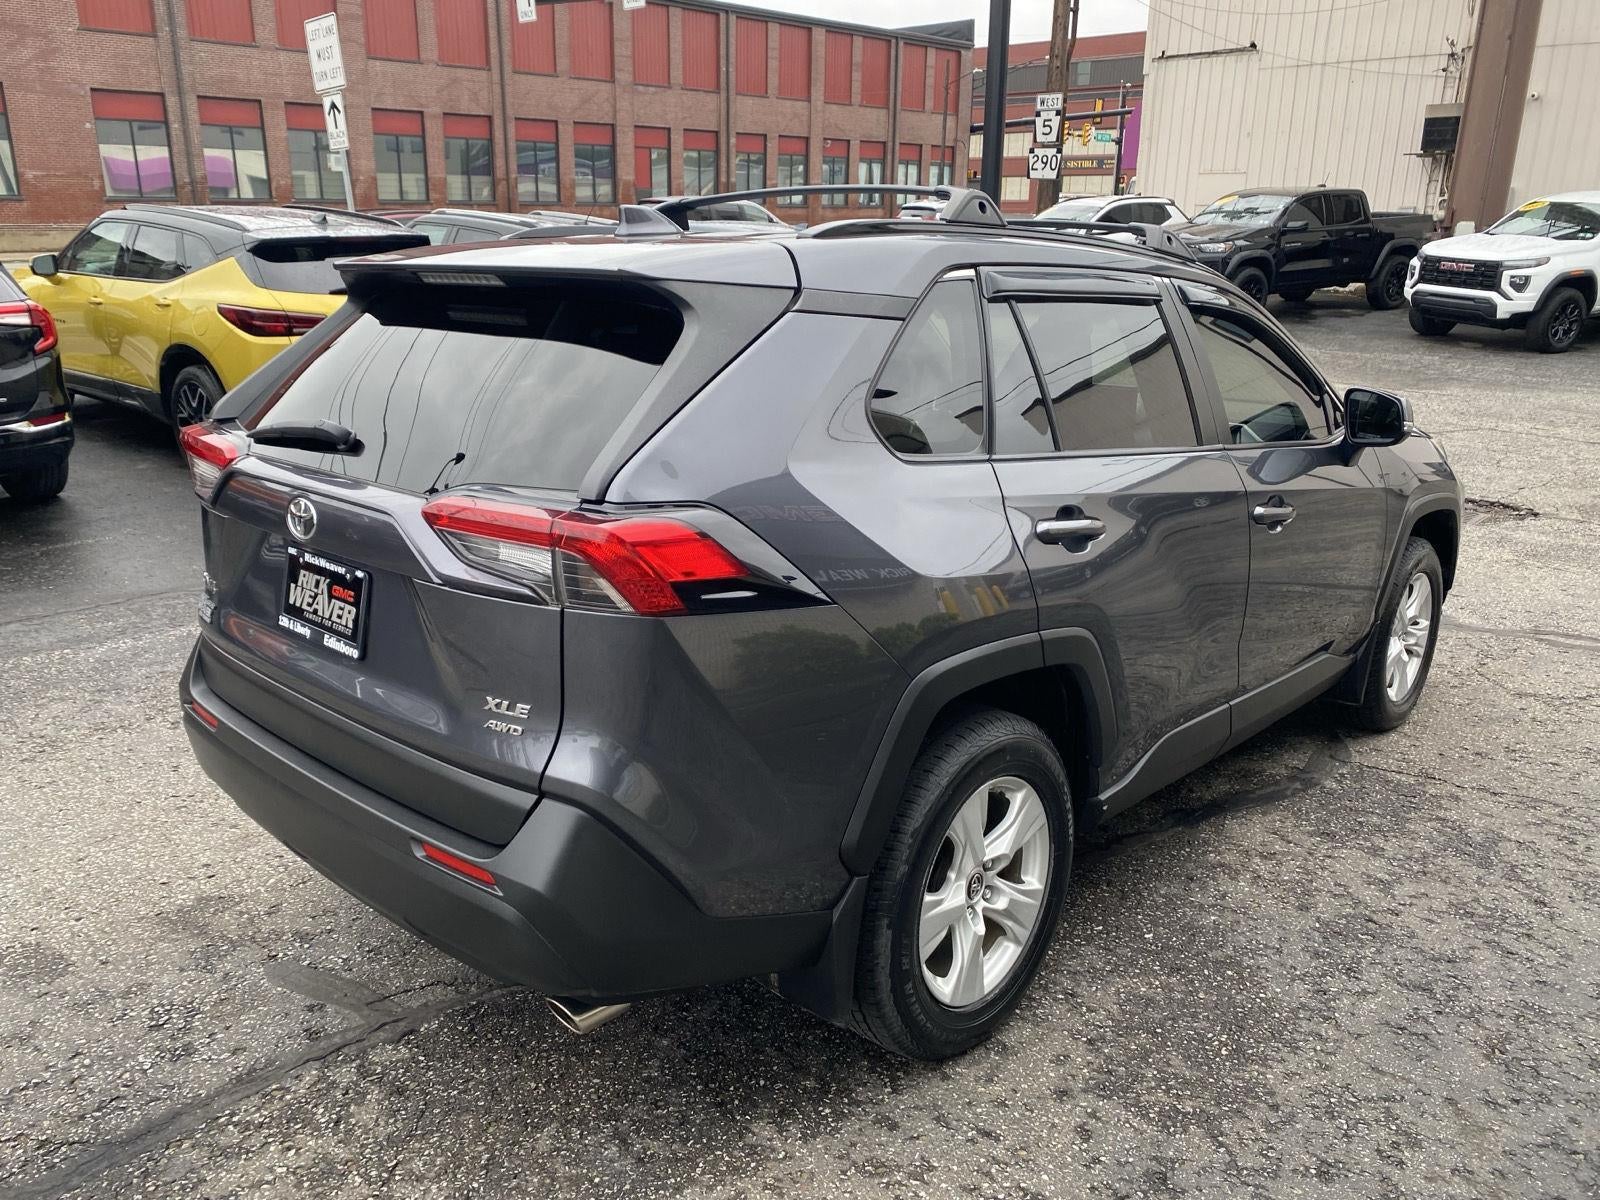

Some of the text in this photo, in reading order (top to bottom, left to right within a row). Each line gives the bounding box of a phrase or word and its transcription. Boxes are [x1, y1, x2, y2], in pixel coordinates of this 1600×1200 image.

[520, 9, 534, 19] ONLY
[310, 23, 336, 42] LEFT LANE
[315, 44, 334, 61] MUST
[314, 65, 342, 82] TURN LEFT
[1039, 97, 1060, 108] WEST
[1042, 118, 1053, 136] 5
[1030, 154, 1059, 172] 290
[1439, 261, 1475, 273] GMC
[304, 552, 346, 575] RickWeaver
[297, 569, 330, 595] RICK
[331, 584, 355, 602] GMC
[288, 582, 357, 629] WEAVER
[303, 611, 352, 636] FAMOUS FOR SERVICE
[323, 633, 359, 659] Edinboro
[482, 696, 532, 719] XLE
[483, 720, 524, 736] AWD
